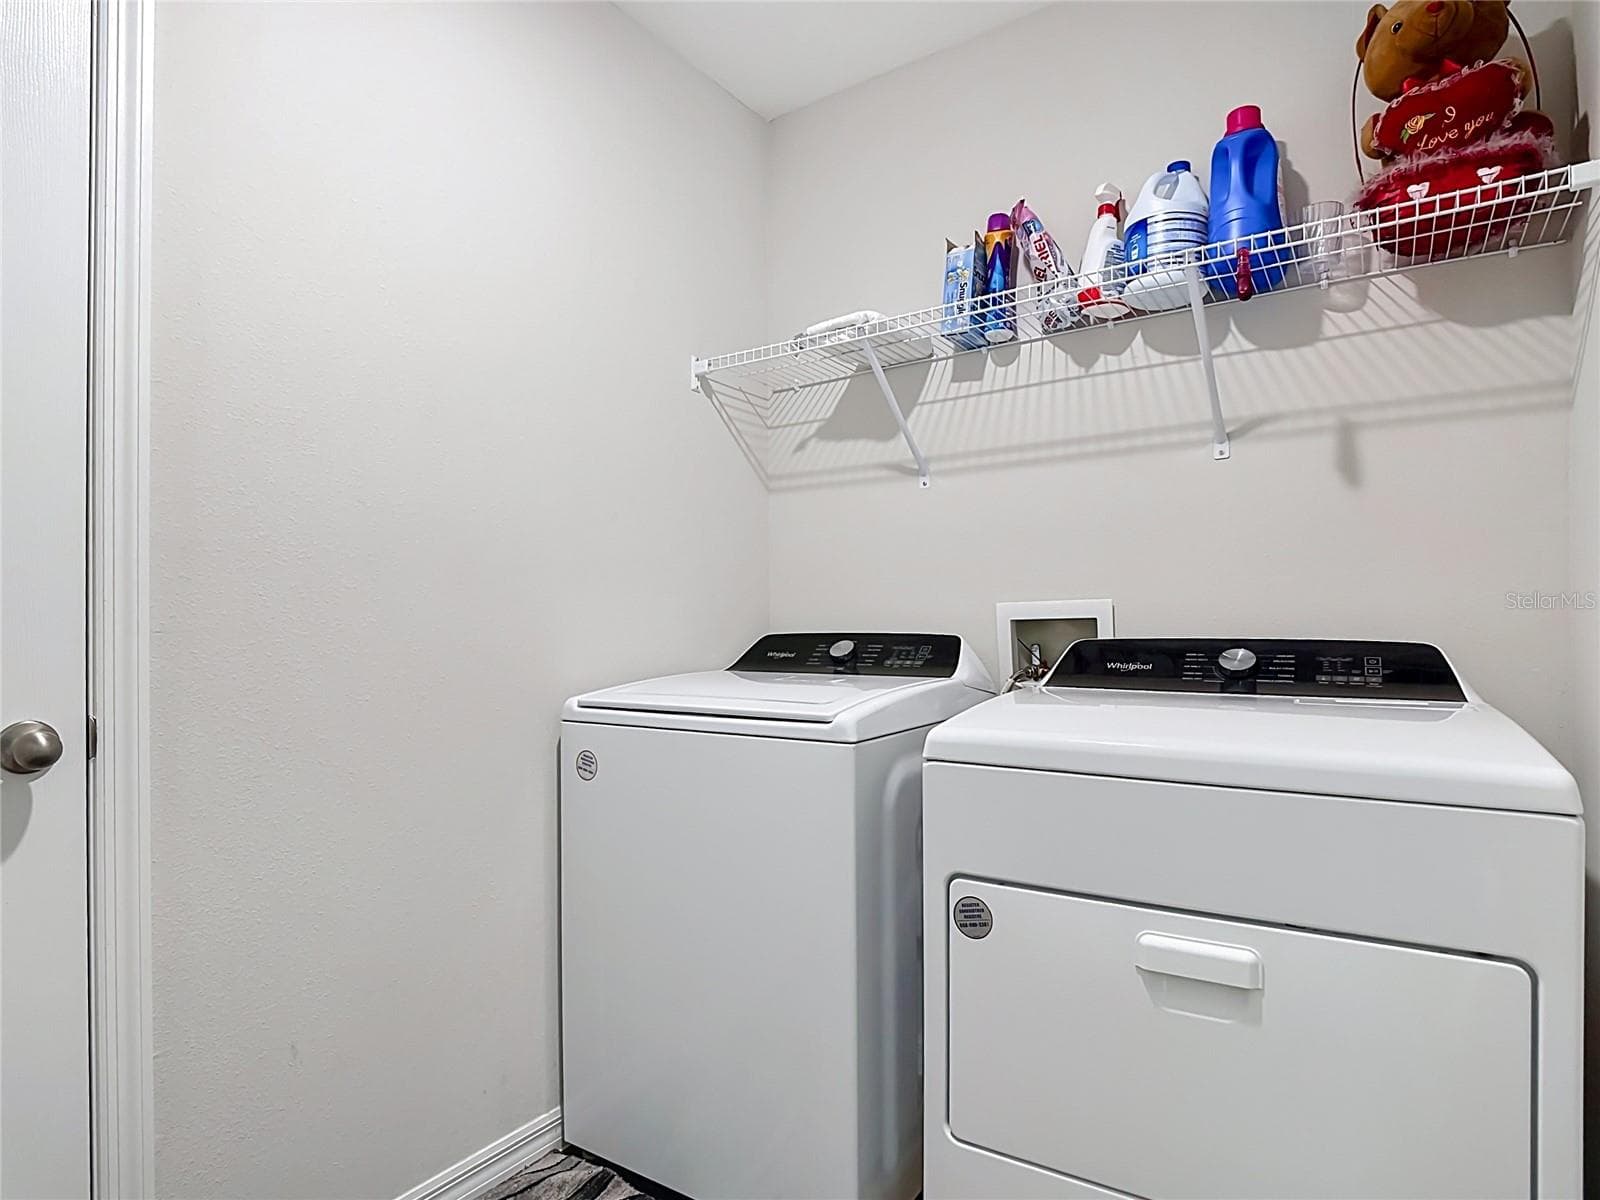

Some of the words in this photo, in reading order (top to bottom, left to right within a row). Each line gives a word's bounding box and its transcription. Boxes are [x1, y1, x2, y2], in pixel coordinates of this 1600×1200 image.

[1417, 129, 1459, 151] Love
[1464, 112, 1494, 140] you
[1106, 661, 1153, 671] Whirlpool
